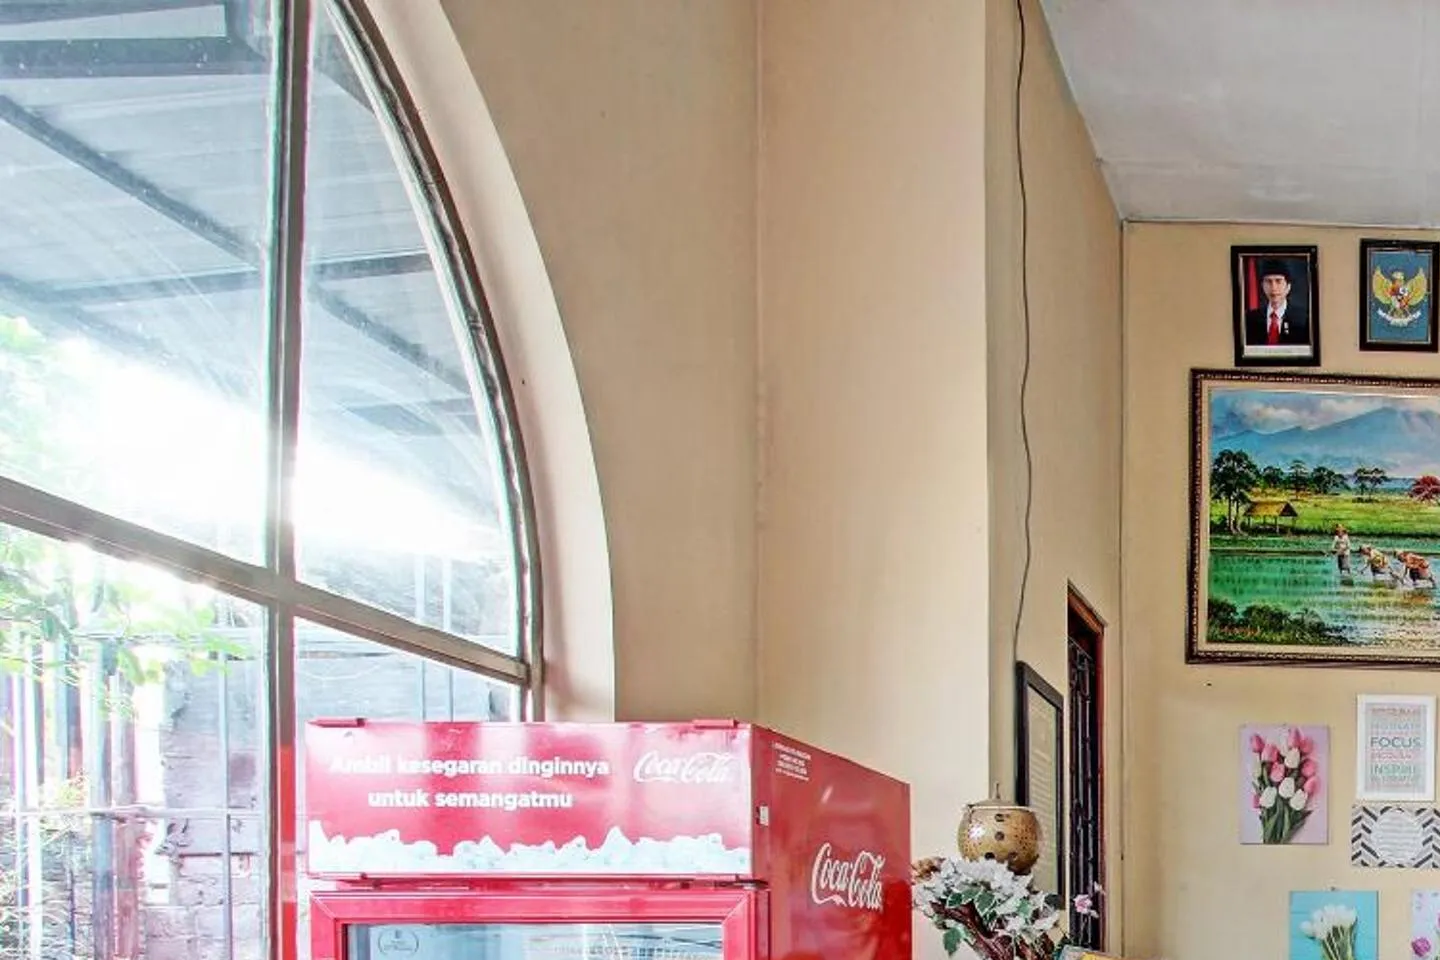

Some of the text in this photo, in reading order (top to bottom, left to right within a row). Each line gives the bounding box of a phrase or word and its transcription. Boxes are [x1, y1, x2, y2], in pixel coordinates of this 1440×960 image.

[1370, 737, 1421, 748] FOCUS
[397, 754, 501, 778] kesegaran
[508, 756, 609, 778] dinginnya
[633, 750, 732, 784] Coca-Cola
[367, 788, 573, 811] untuk semangatmu
[812, 842, 885, 911] Coca-Cola
